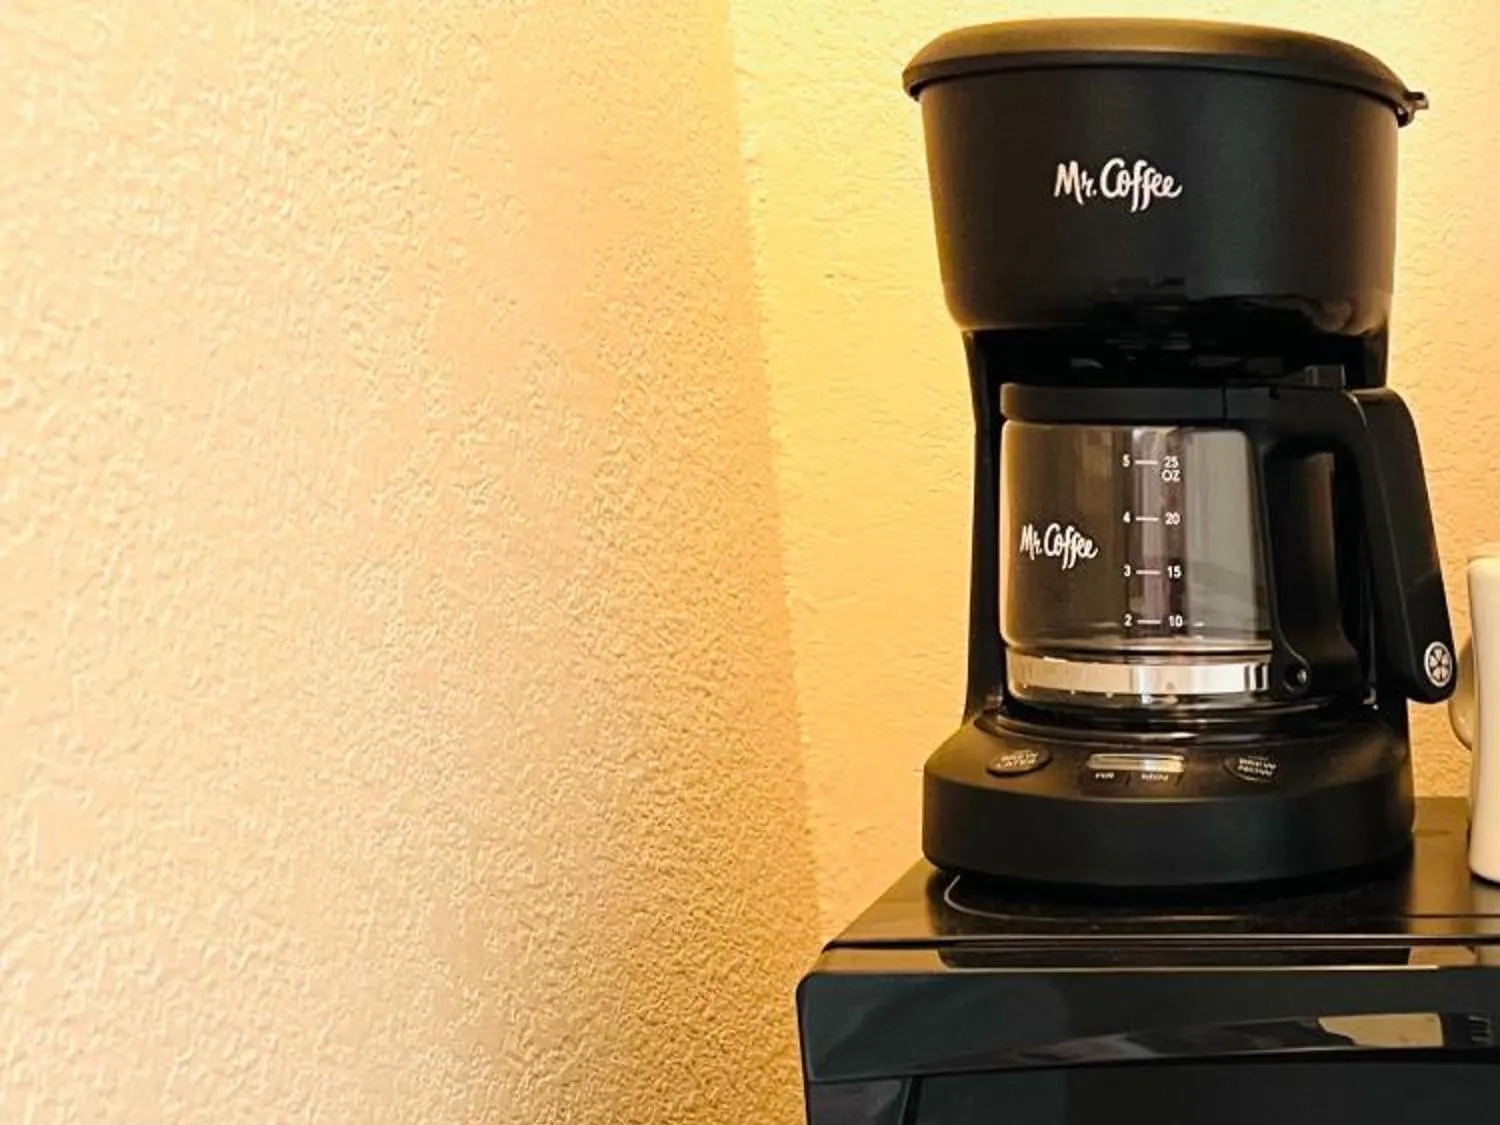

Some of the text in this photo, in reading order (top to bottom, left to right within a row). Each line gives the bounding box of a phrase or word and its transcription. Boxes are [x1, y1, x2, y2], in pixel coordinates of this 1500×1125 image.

[1053, 156, 1184, 214] Mr. Coffee
[1122, 454, 1180, 469] 5 25
[1161, 469, 1182, 483] OZ
[1122, 511, 1182, 526] 4 20
[1020, 522, 1099, 571] Mr. Coffee
[1123, 564, 1183, 579] 3 15
[1124, 614, 1184, 628] 2 10
